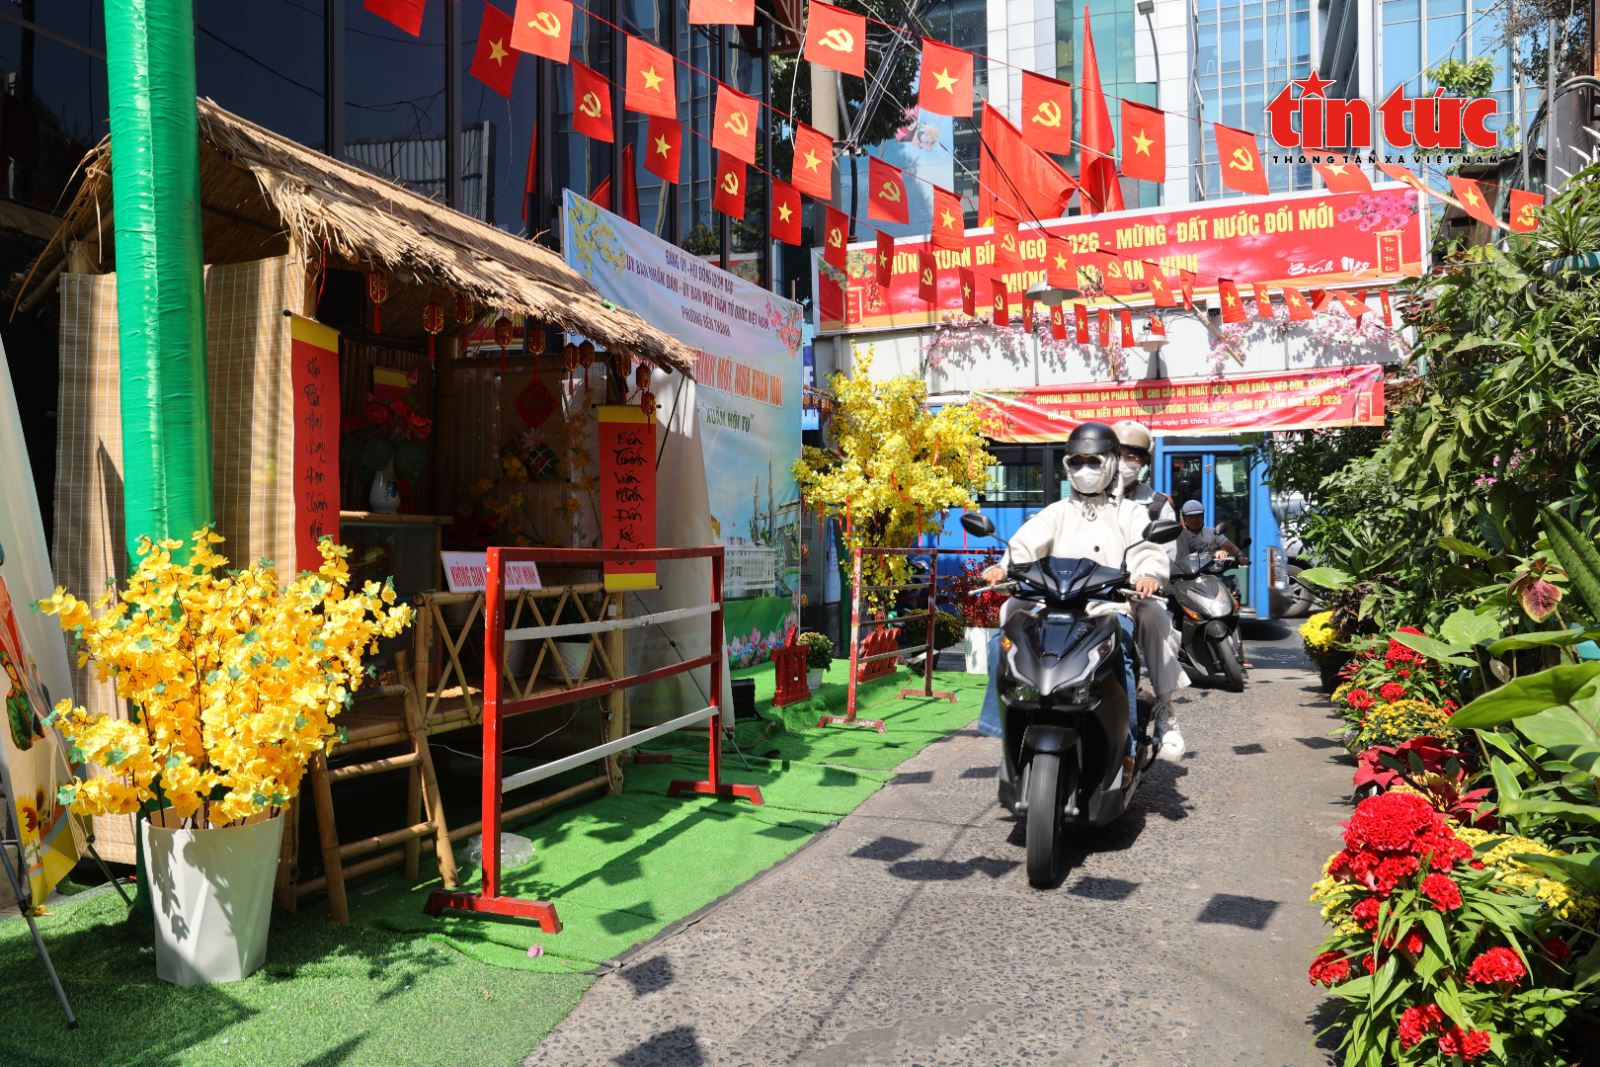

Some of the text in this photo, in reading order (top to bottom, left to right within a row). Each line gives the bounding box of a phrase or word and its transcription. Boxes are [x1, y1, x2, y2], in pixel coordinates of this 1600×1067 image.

[1060, 232, 1100, 255] 026
[1116, 223, 1167, 249] MỪNG
[1176, 215, 1208, 243] ĐẤT
[1213, 210, 1260, 240] NƯỚC
[1264, 205, 1294, 234] ĐỔI
[1299, 201, 1335, 231] MỚI
[1160, 254, 1199, 277] VINH
